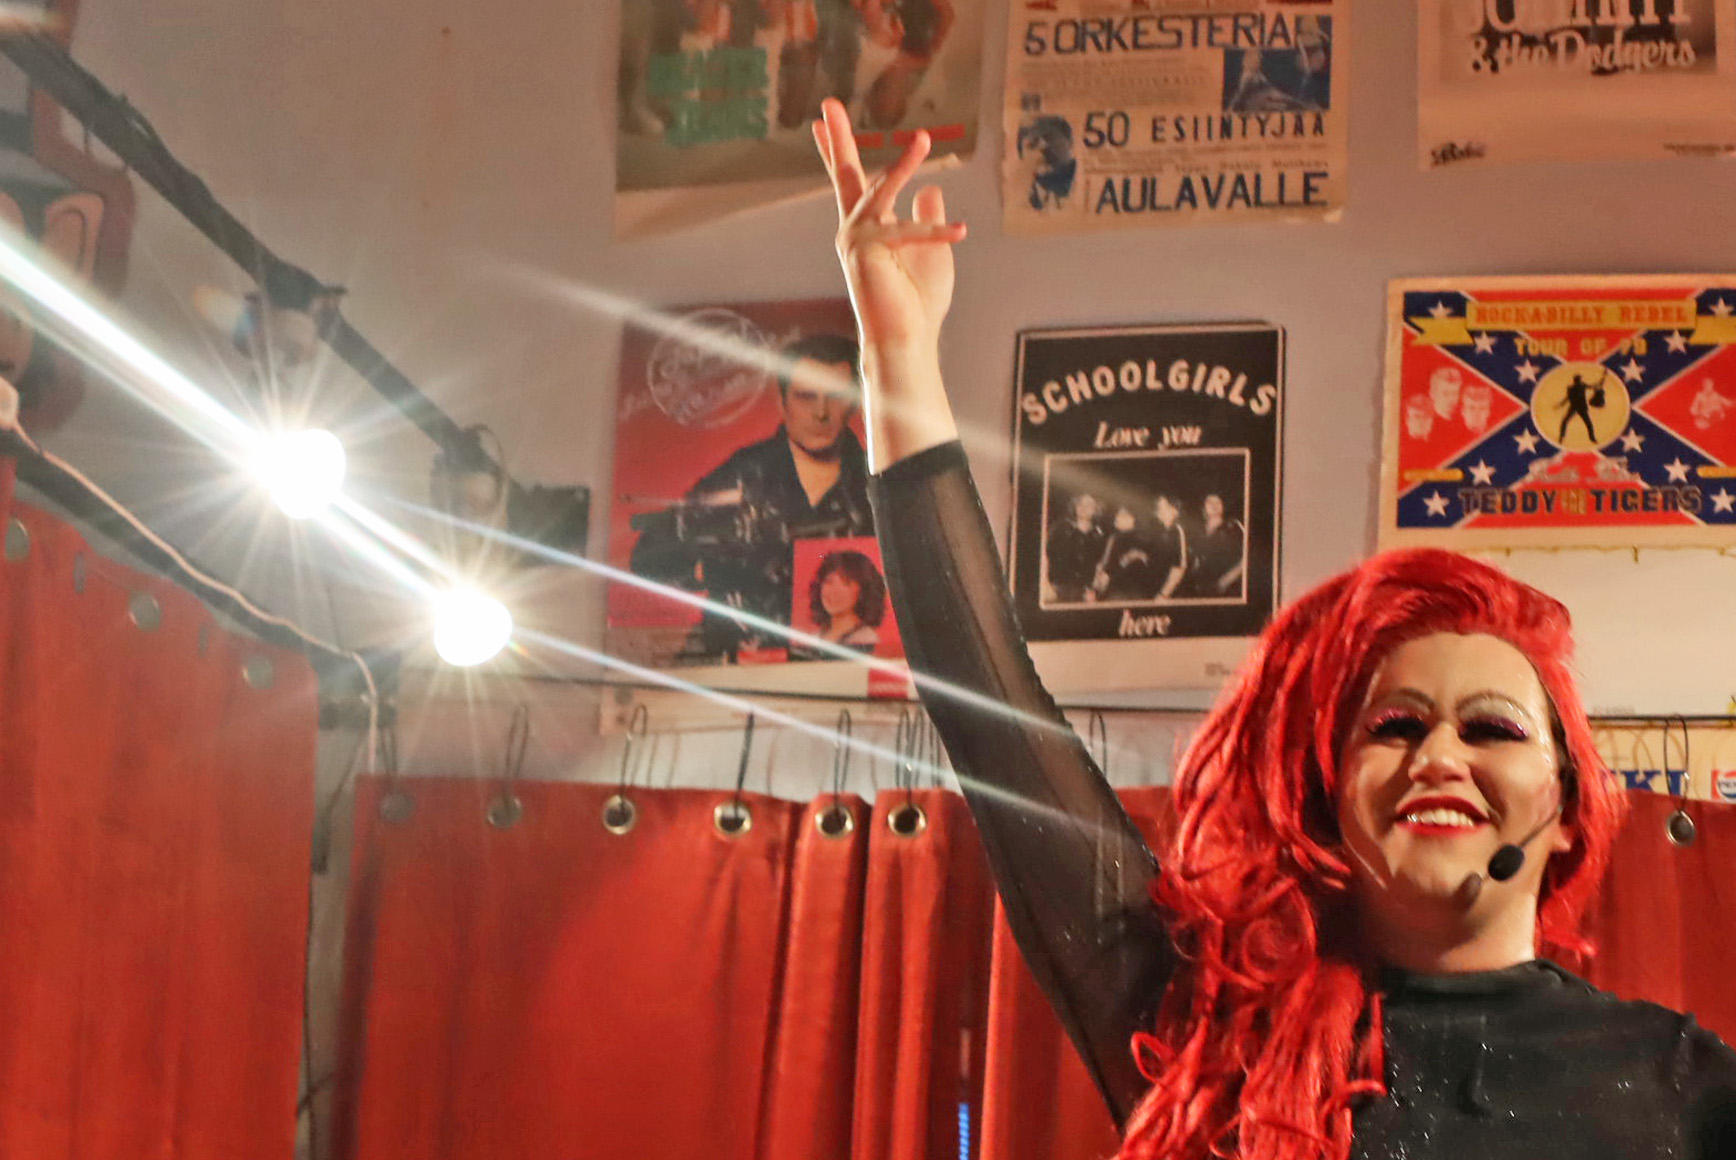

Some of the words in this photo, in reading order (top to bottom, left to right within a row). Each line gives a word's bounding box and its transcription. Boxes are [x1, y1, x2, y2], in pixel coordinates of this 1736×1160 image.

[1024, 21, 1046, 56] 5
[1054, 13, 1291, 53] ORKESTERIA
[1083, 111, 1130, 149] 50
[1095, 171, 1329, 214] AULAVALLE
[1475, 304, 1603, 324] ROCKABILLY
[1620, 303, 1688, 323] REBEL
[1514, 337, 1568, 356] TOUR
[1580, 337, 1607, 355] OF
[1021, 359, 1277, 424] SCHOOLGIRLS
[1458, 488, 1557, 515] TEDDY
[1590, 485, 1702, 515] TIGERS
[1118, 609, 1172, 637] here
